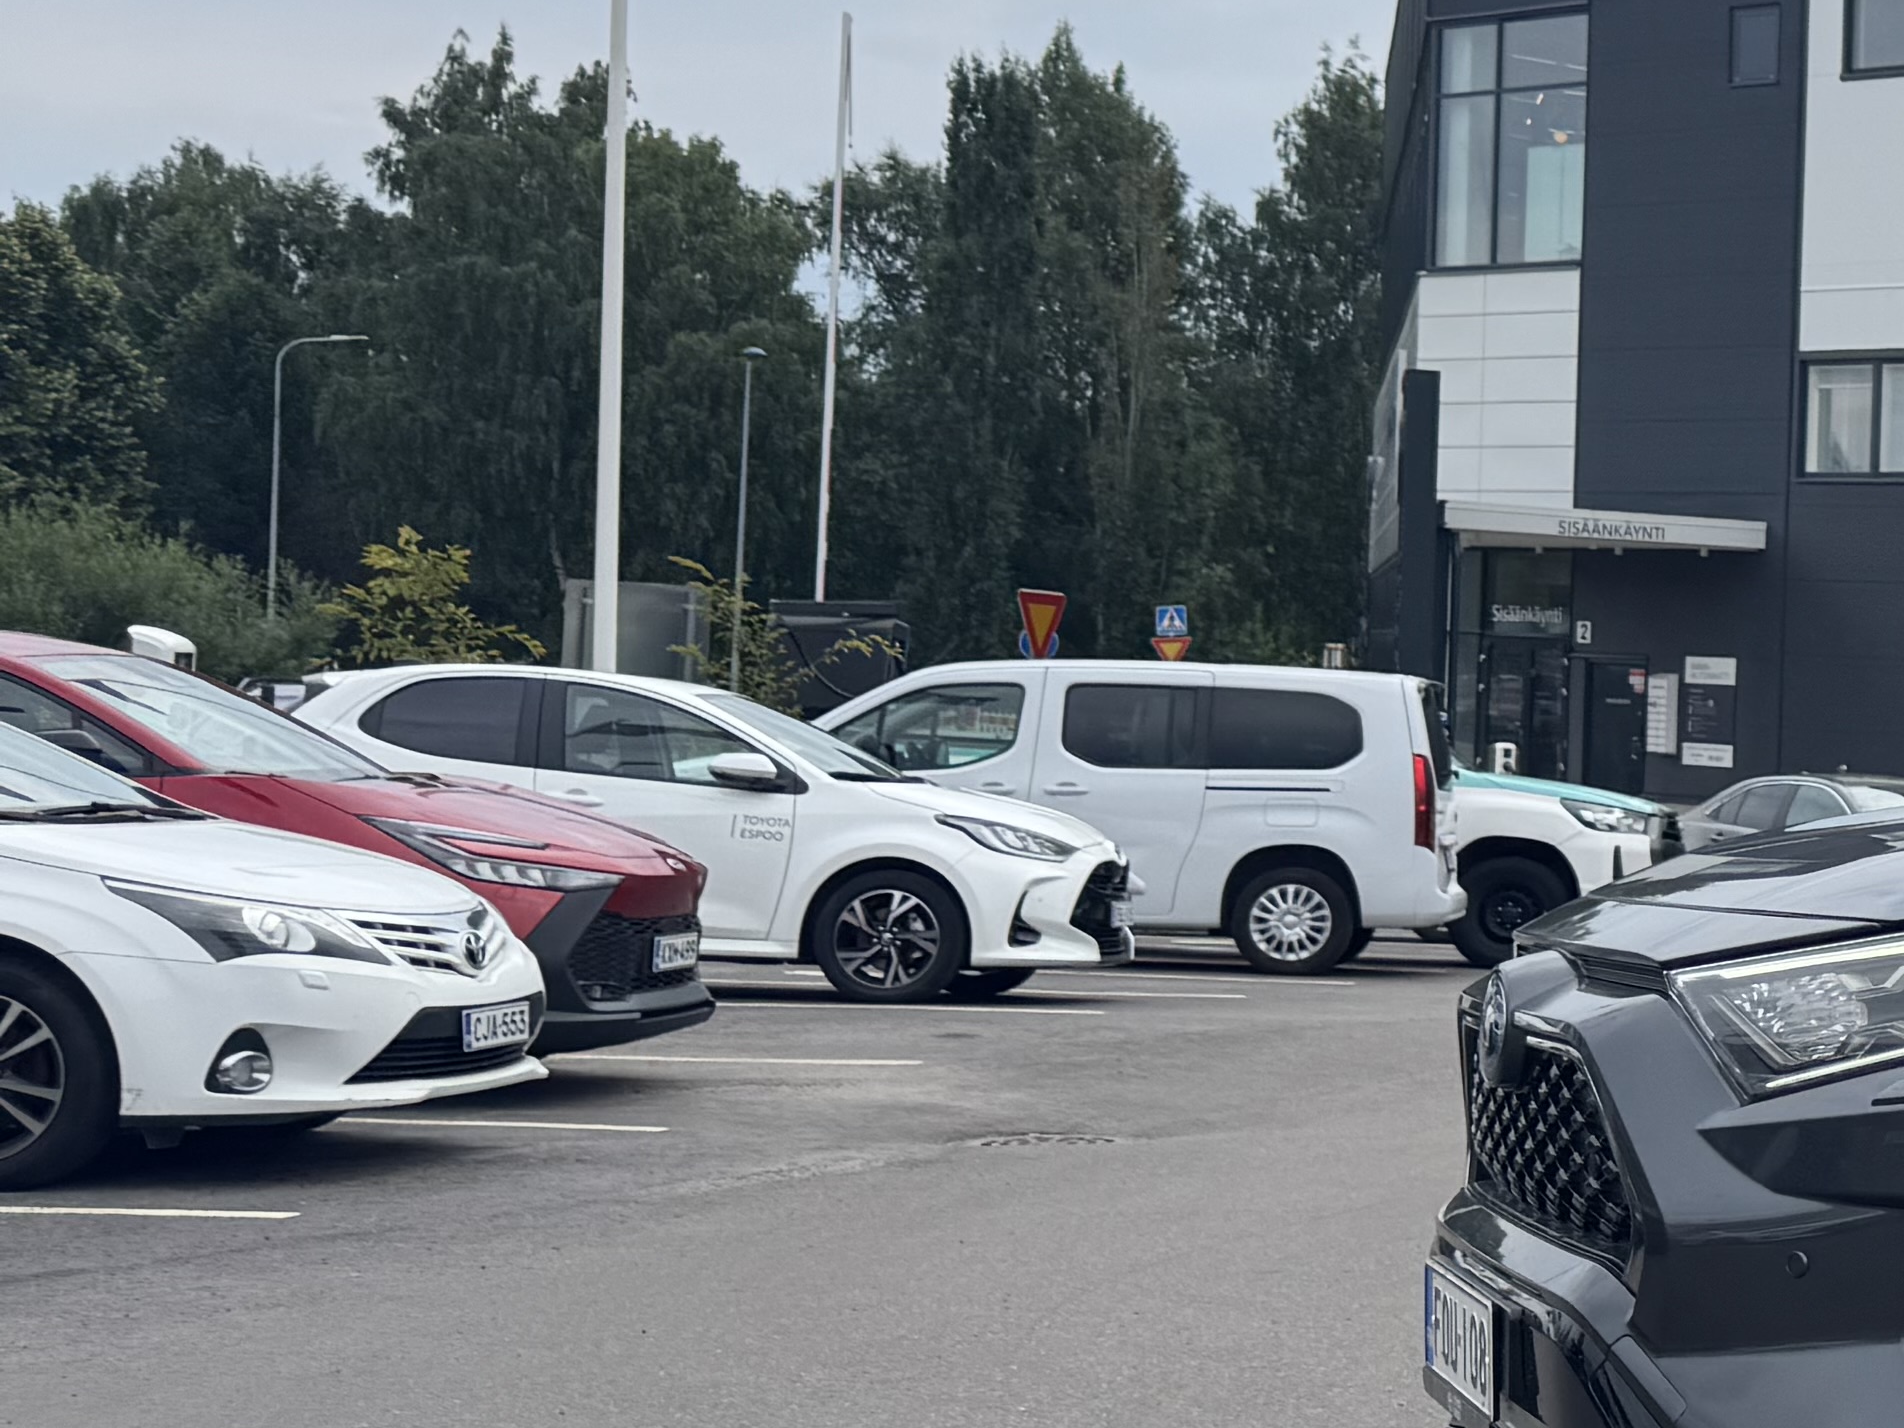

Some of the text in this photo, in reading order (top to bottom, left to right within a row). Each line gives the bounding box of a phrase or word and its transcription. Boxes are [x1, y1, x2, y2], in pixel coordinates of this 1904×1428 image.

[1558, 517, 1666, 540] SISÄÄNKÄYNTI
[1492, 604, 1563, 628] Sisäänkäynti
[1580, 623, 1588, 641] 2
[743, 814, 792, 828] TOYOTA
[740, 827, 784, 842] ESPOO
[474, 1009, 526, 1043] CJA-553
[1434, 1285, 1487, 1398] FOU-108
